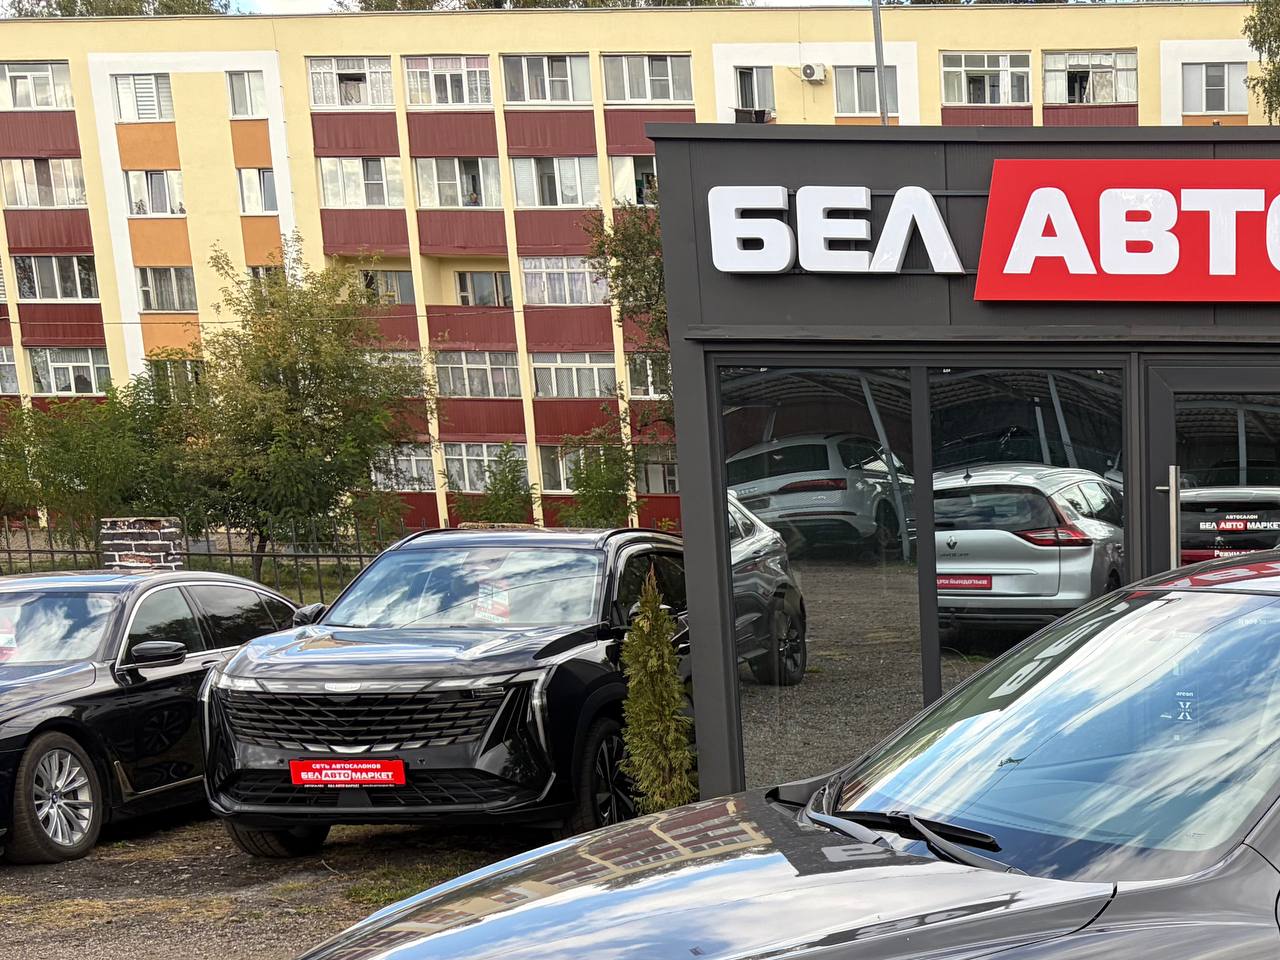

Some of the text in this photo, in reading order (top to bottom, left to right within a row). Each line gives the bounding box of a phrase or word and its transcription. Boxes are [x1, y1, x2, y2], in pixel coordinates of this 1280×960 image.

[707, 185, 964, 274] БЕЛ
[1199, 521, 1217, 530] БЕЛ
[1219, 521, 1244, 529] АВТО
[301, 771, 394, 780] БЕЛ АВТО МАРКЕТ
